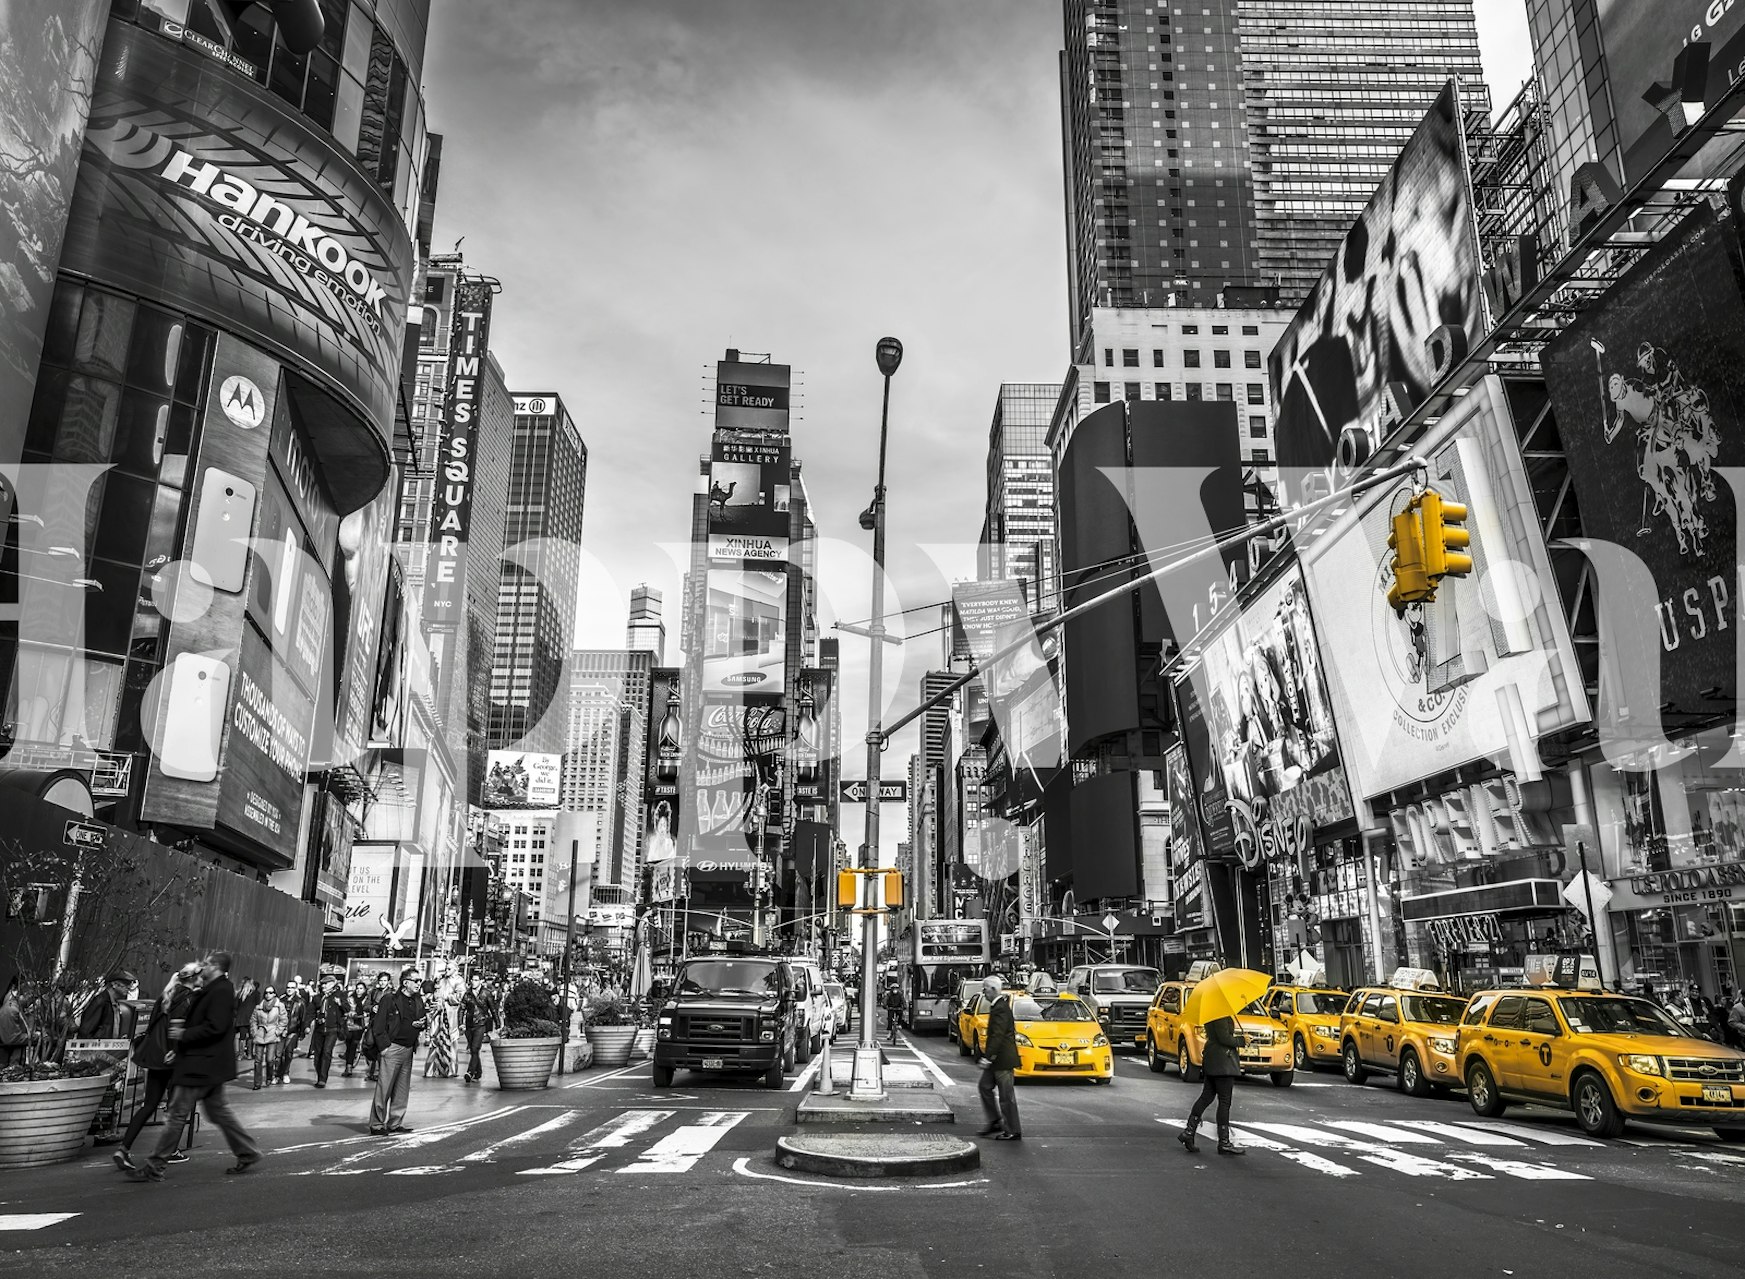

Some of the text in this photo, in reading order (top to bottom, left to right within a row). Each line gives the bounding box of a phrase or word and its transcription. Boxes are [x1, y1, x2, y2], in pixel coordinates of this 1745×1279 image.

[217, 213, 382, 336] driving emotion
[720, 385, 747, 395] LET'S
[720, 395, 774, 407] GET READY
[436, 312, 483, 583] TIMES SQUARE
[754, 447, 780, 455] XINHUA
[723, 453, 779, 464] GALLERY
[726, 537, 772, 550] XINHUA
[715, 547, 782, 559] NEWS AGENCY
[434, 600, 452, 608] NYC
[726, 675, 761, 683] SAMSUNG
[240, 671, 278, 731] THOUSANDS
[277, 714, 286, 738] OF
[1393, 682, 1470, 741] COLLECTION EXCLUSIV
[234, 701, 270, 755] CUSTOMIZE
[619, 716, 630, 776] NOVOTEL
[655, 786, 677, 795] #TASTE
[1388, 773, 1550, 871] FOREVER
[1225, 795, 1314, 882] Disney
[359, 866, 371, 874] US
[1023, 833, 1032, 913] PALACE
[352, 875, 381, 884] ON THE
[1654, 869, 1707, 892] POLO
[1663, 888, 1732, 904] SINCE 1890
[1428, 914, 1487, 944] FOREVER
